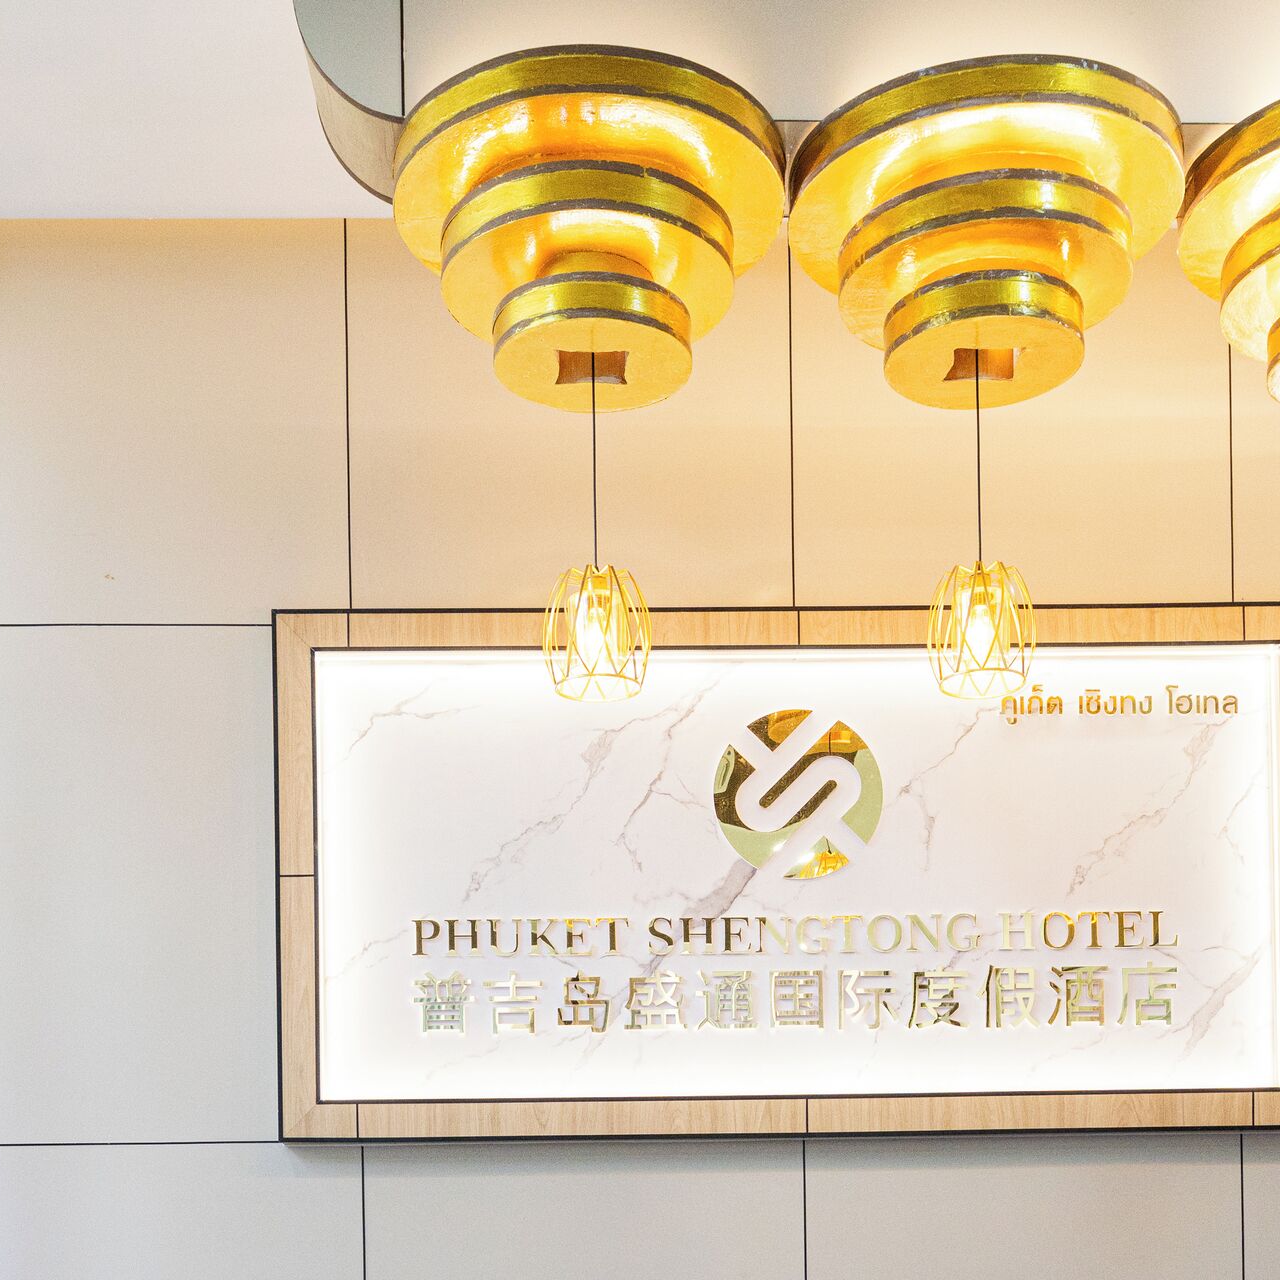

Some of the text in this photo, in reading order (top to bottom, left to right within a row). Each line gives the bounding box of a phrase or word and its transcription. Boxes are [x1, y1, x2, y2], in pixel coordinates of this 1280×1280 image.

[1000, 684, 1239, 725] ภูเก็ต เชิงทง โฮเทล
[411, 909, 1179, 958] PHUKET SHENGTONG HOTEL
[412, 961, 1178, 1035] 普吉岛盛通国际度假酒店
